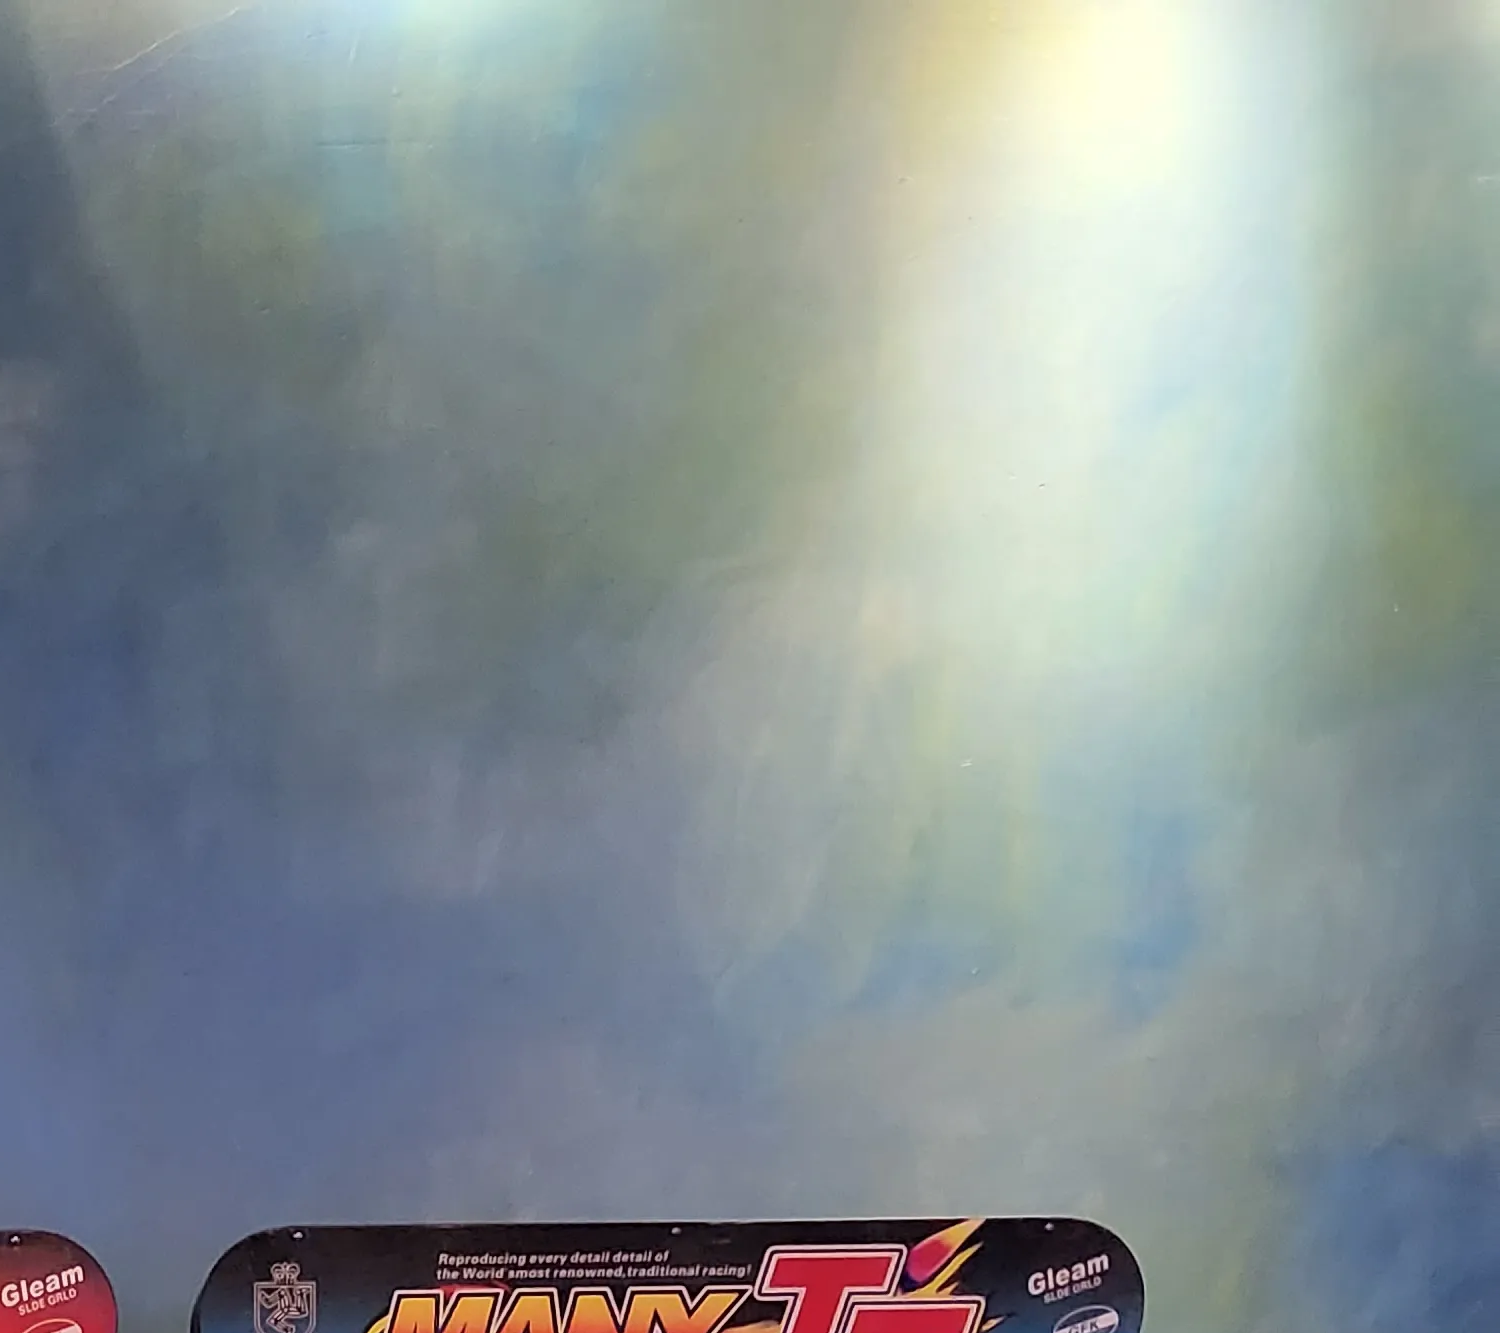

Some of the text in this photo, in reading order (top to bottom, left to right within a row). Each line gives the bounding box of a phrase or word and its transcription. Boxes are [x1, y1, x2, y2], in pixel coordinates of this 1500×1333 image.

[438, 1250, 670, 1267] Reproducing every detail detail of
[1, 1265, 85, 1307] Gleam
[436, 1267, 461, 1280] the
[1027, 1253, 1110, 1296] Gleam
